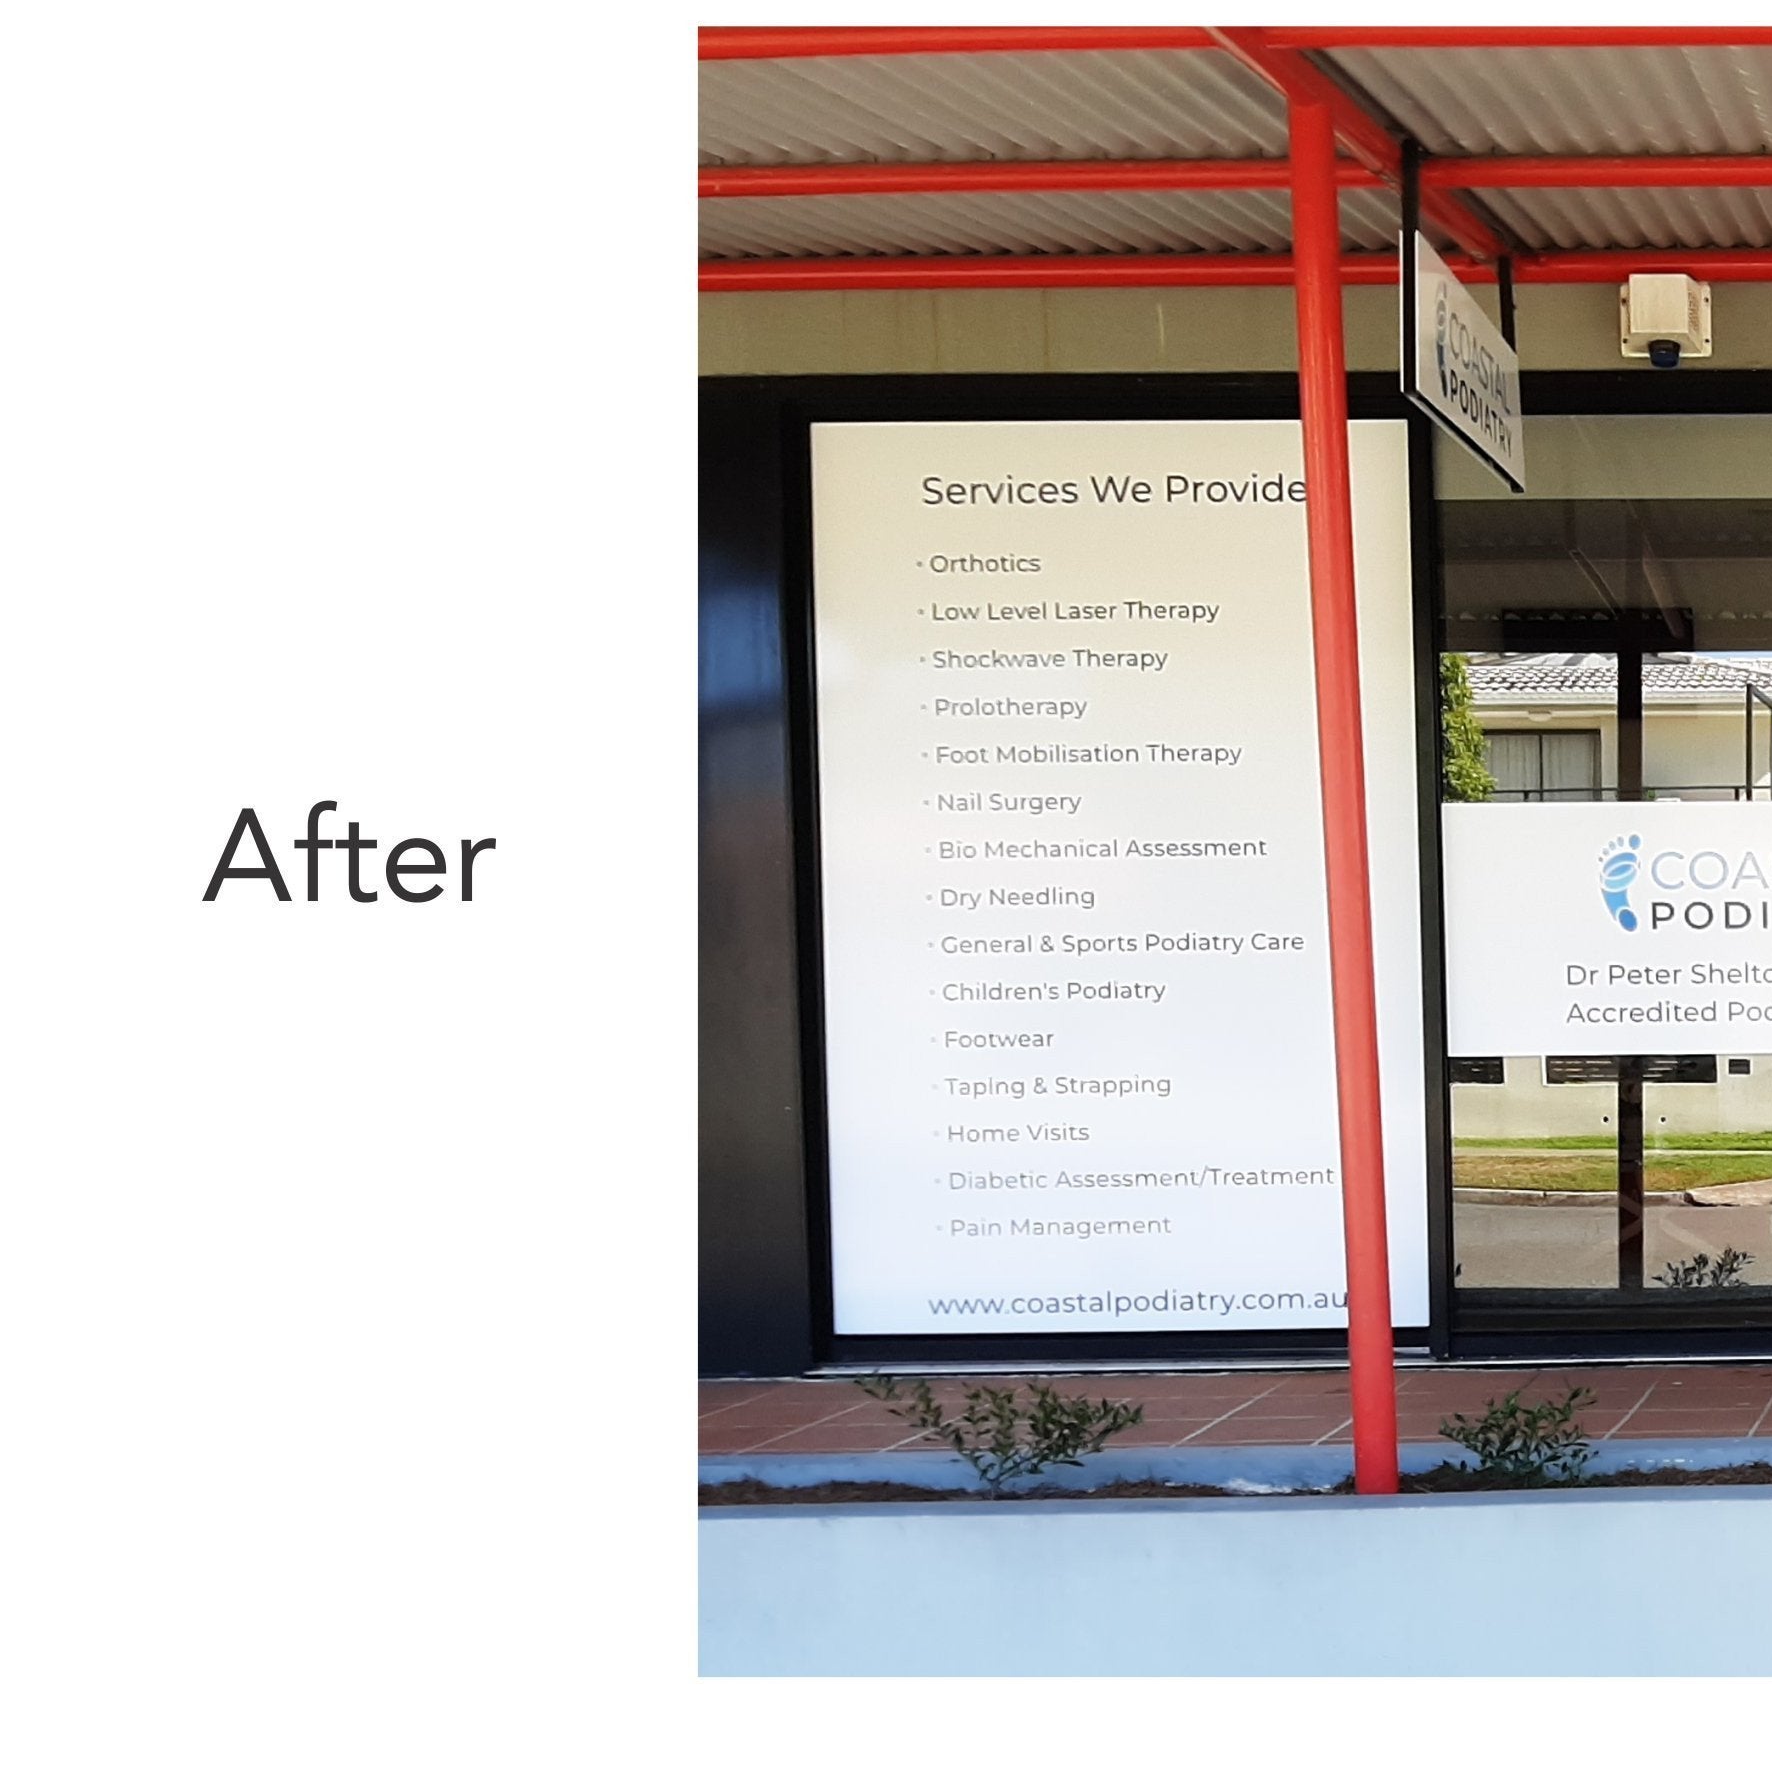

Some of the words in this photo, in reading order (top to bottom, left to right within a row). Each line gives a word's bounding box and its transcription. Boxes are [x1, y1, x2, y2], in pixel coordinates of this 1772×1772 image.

[1450, 312, 1511, 415] COASTAL
[1450, 369, 1512, 458] PODIATRY
[922, 476, 1078, 506] Services
[1090, 476, 1152, 503] We
[1166, 473, 1309, 503] Provide
[930, 555, 1041, 574] Orthotics
[932, 603, 980, 621] Low
[987, 602, 1048, 621] Level
[1055, 602, 1117, 620] Laser
[1124, 601, 1219, 623] Therapy
[932, 650, 1066, 669] Shockwave
[1073, 649, 1168, 671] Therapy
[935, 698, 1087, 719] Prolotherapy
[936, 746, 989, 764] Foot
[996, 744, 1139, 763] Mobilisation
[1146, 744, 1242, 766] Therapy
[937, 794, 982, 811] Nail
[989, 793, 1082, 815] Surgery
[940, 840, 977, 859] Bio
[985, 840, 1118, 859] Mechanical
[1126, 839, 1267, 858] Assessment
[940, 888, 981, 910] Dry
[989, 887, 1095, 909] Needling
[941, 935, 1033, 954] General
[1062, 934, 1137, 956] Sports
[1145, 933, 1244, 955] Podiatry
[1251, 933, 1304, 951] Care
[1567, 964, 1599, 986] Dr
[1608, 964, 1682, 985] Peter
[943, 983, 1060, 1002] Children's
[1067, 982, 1166, 1003] Podiatry
[1566, 1000, 1717, 1024] Accredited
[944, 1031, 1054, 1048] Footwear
[945, 1078, 1025, 1099] Taping
[1055, 1075, 1171, 1097] Strapping
[948, 1125, 1020, 1143] Home
[1027, 1123, 1090, 1141] Visits
[949, 1171, 1048, 1190] Diabetic
[1055, 1165, 1335, 1189] Assessment/Treatment
[951, 1218, 1001, 1237] Pain
[1010, 1216, 1172, 1239] Management
[929, 1290, 1349, 1317] www.coastalpodiatry.com.au
